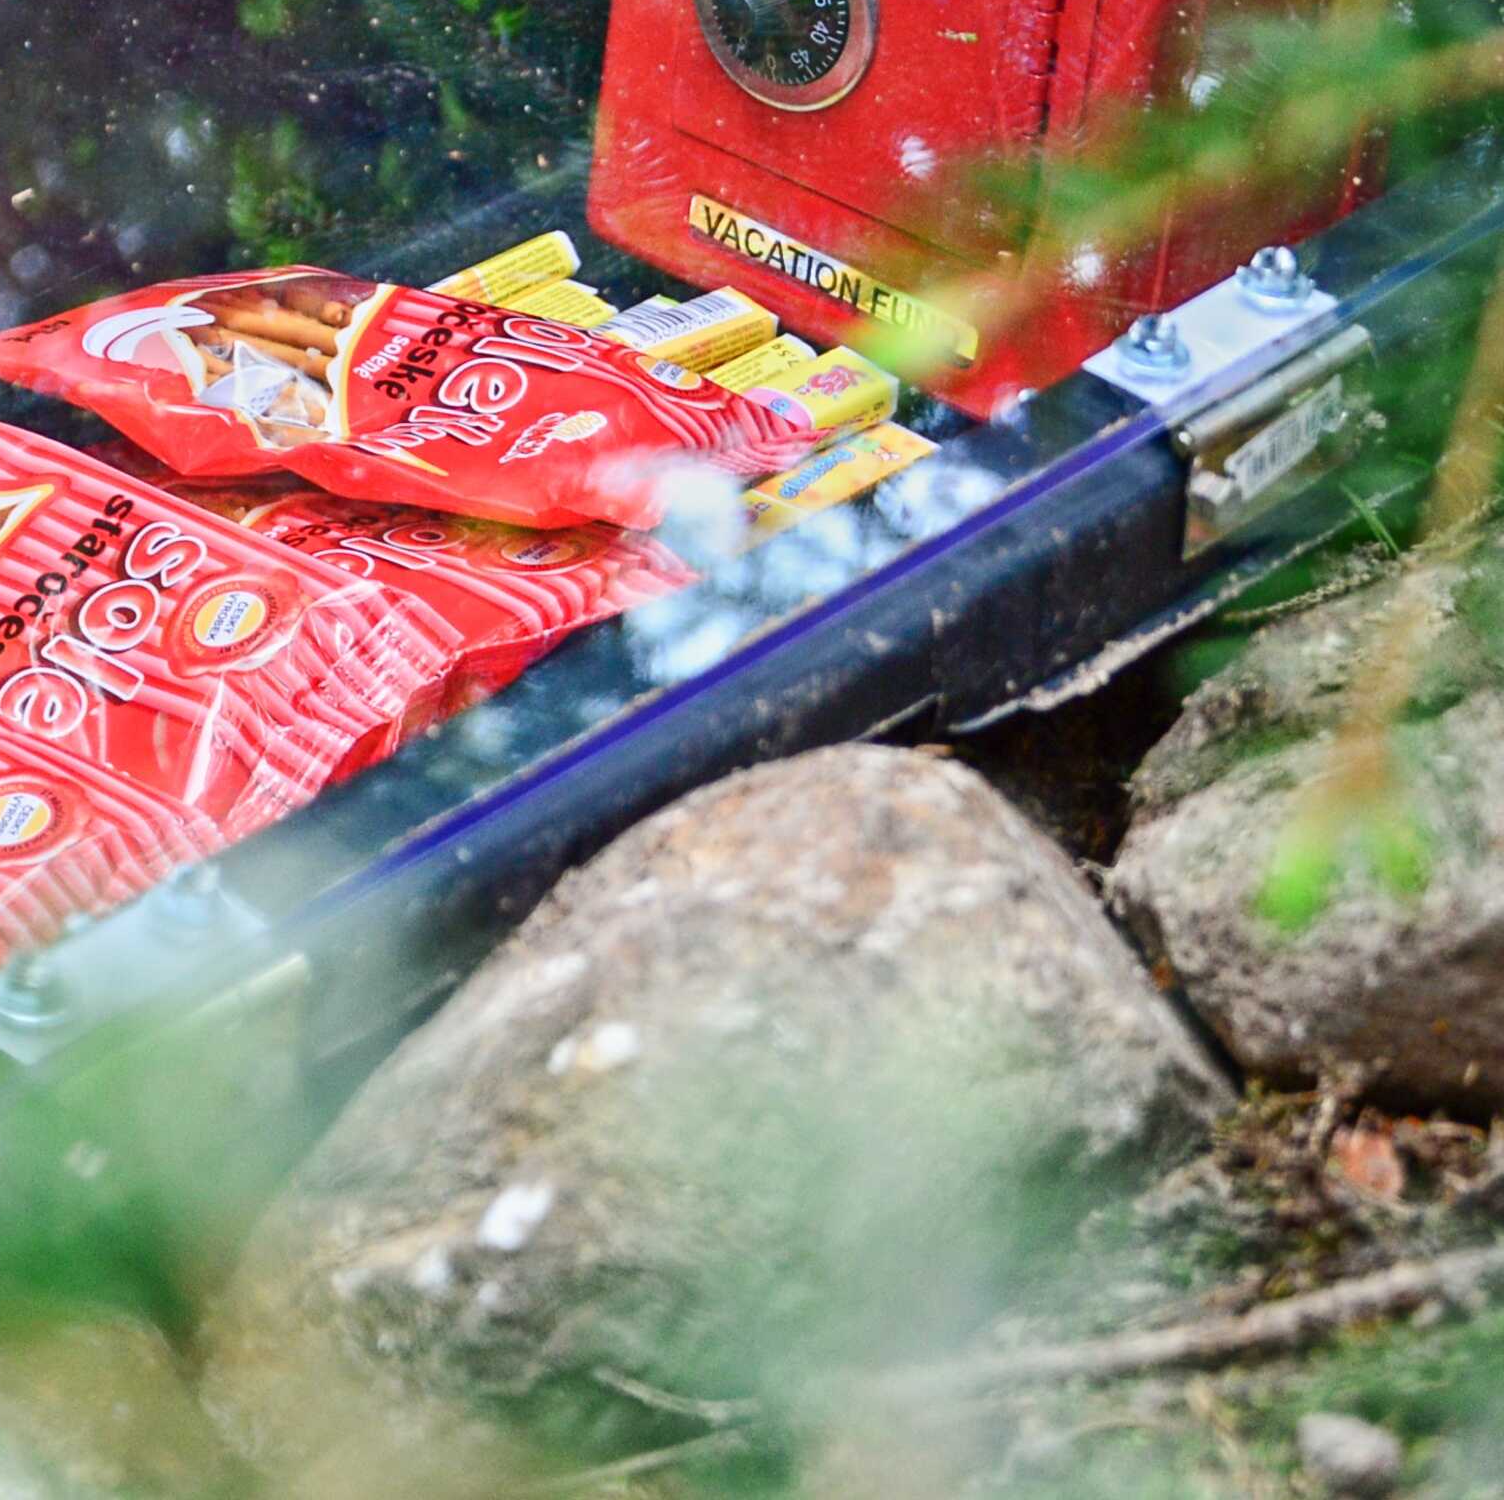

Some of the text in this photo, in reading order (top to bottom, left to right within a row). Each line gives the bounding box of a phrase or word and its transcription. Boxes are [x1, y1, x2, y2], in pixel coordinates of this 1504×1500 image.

[809, 21, 829, 45] 40
[790, 48, 811, 69] 45
[704, 204, 948, 338] VACATION FUN
[353, 335, 411, 381] solené
